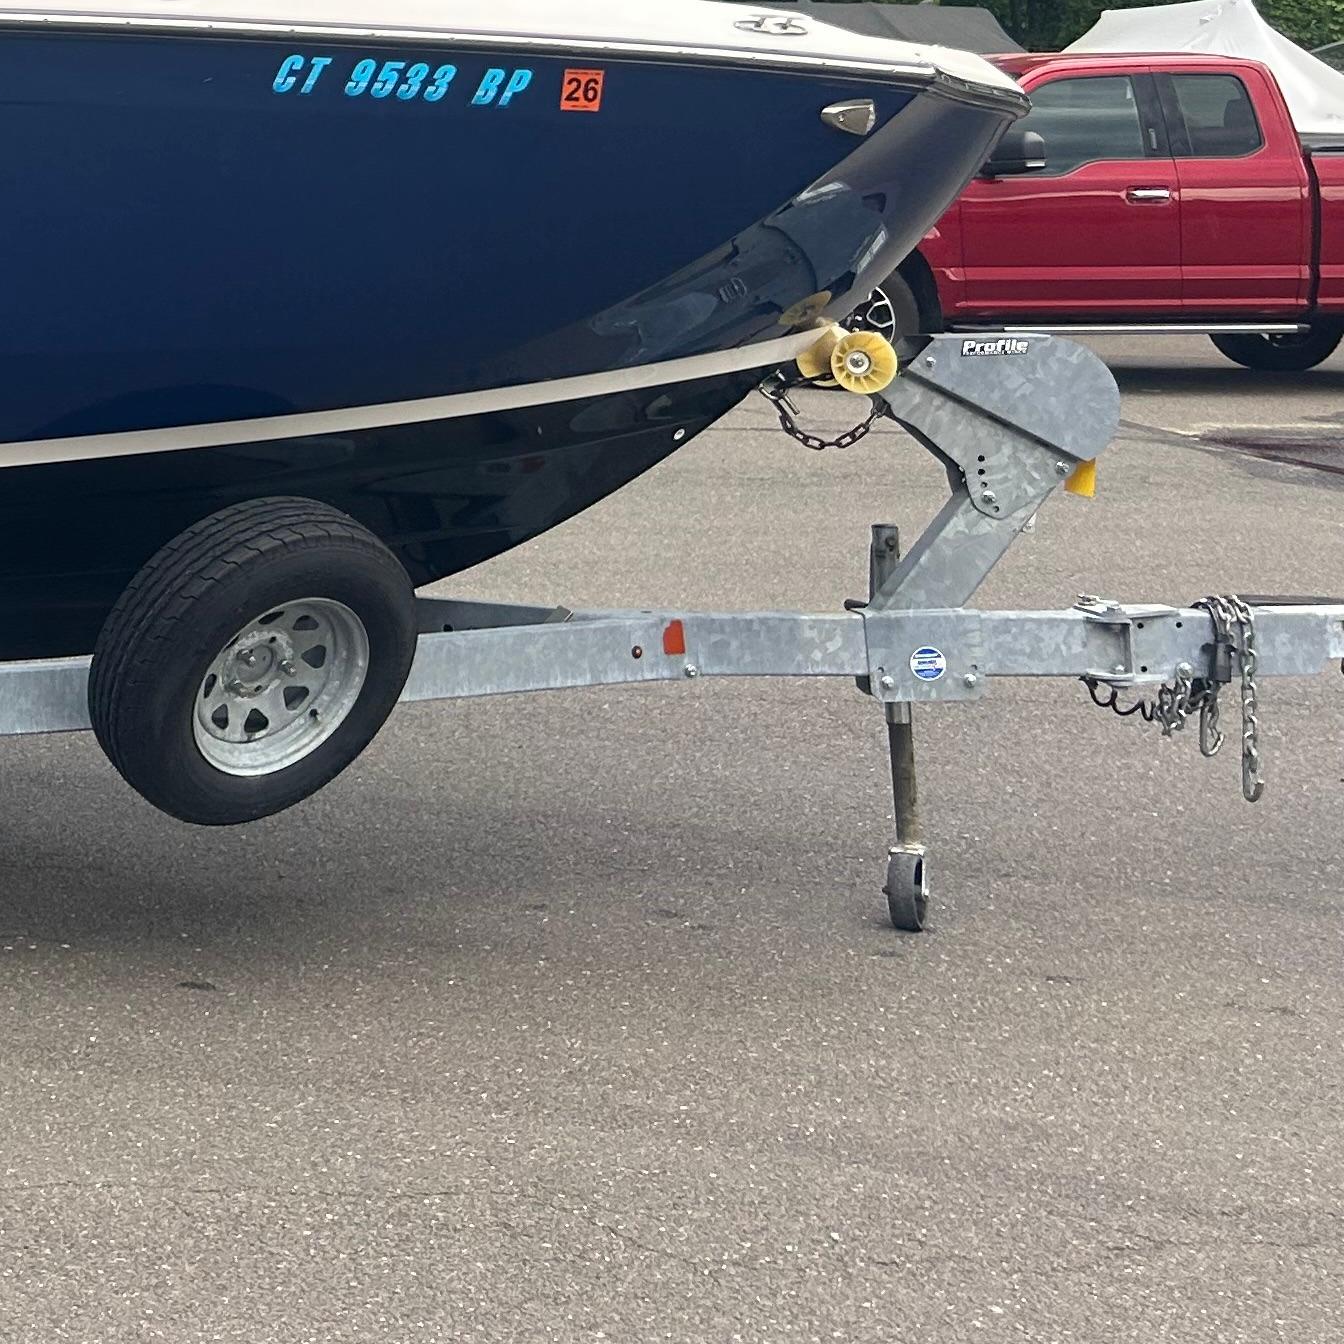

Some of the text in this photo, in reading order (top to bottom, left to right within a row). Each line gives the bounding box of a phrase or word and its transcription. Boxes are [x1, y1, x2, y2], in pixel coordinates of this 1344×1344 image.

[272, 54, 534, 107] CT 9533 BP
[564, 77, 599, 103] 26
[963, 339, 1029, 353] Profile
